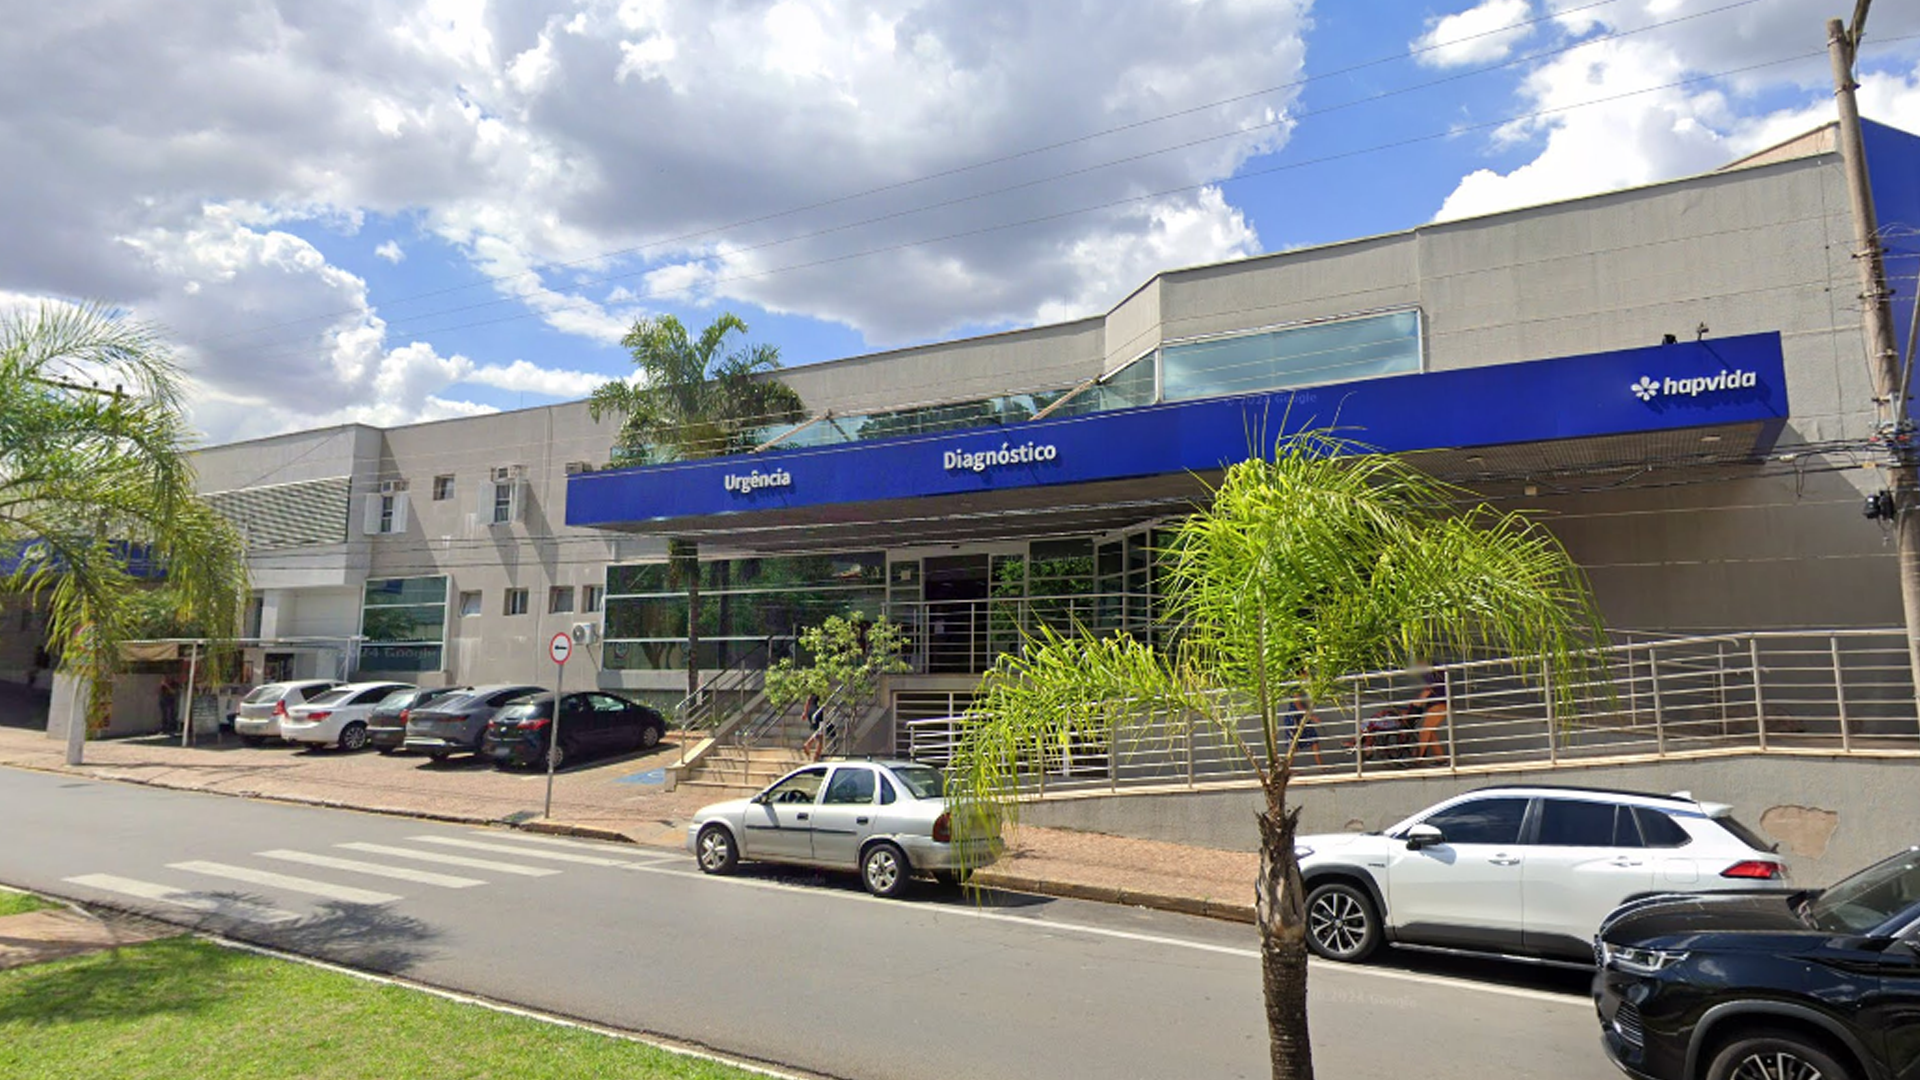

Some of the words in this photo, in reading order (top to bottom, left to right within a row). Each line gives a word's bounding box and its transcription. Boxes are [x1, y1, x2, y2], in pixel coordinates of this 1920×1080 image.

[1663, 369, 1756, 397] hapvida
[943, 441, 1057, 473] Diagnóstico
[724, 467, 792, 494] Urgência
